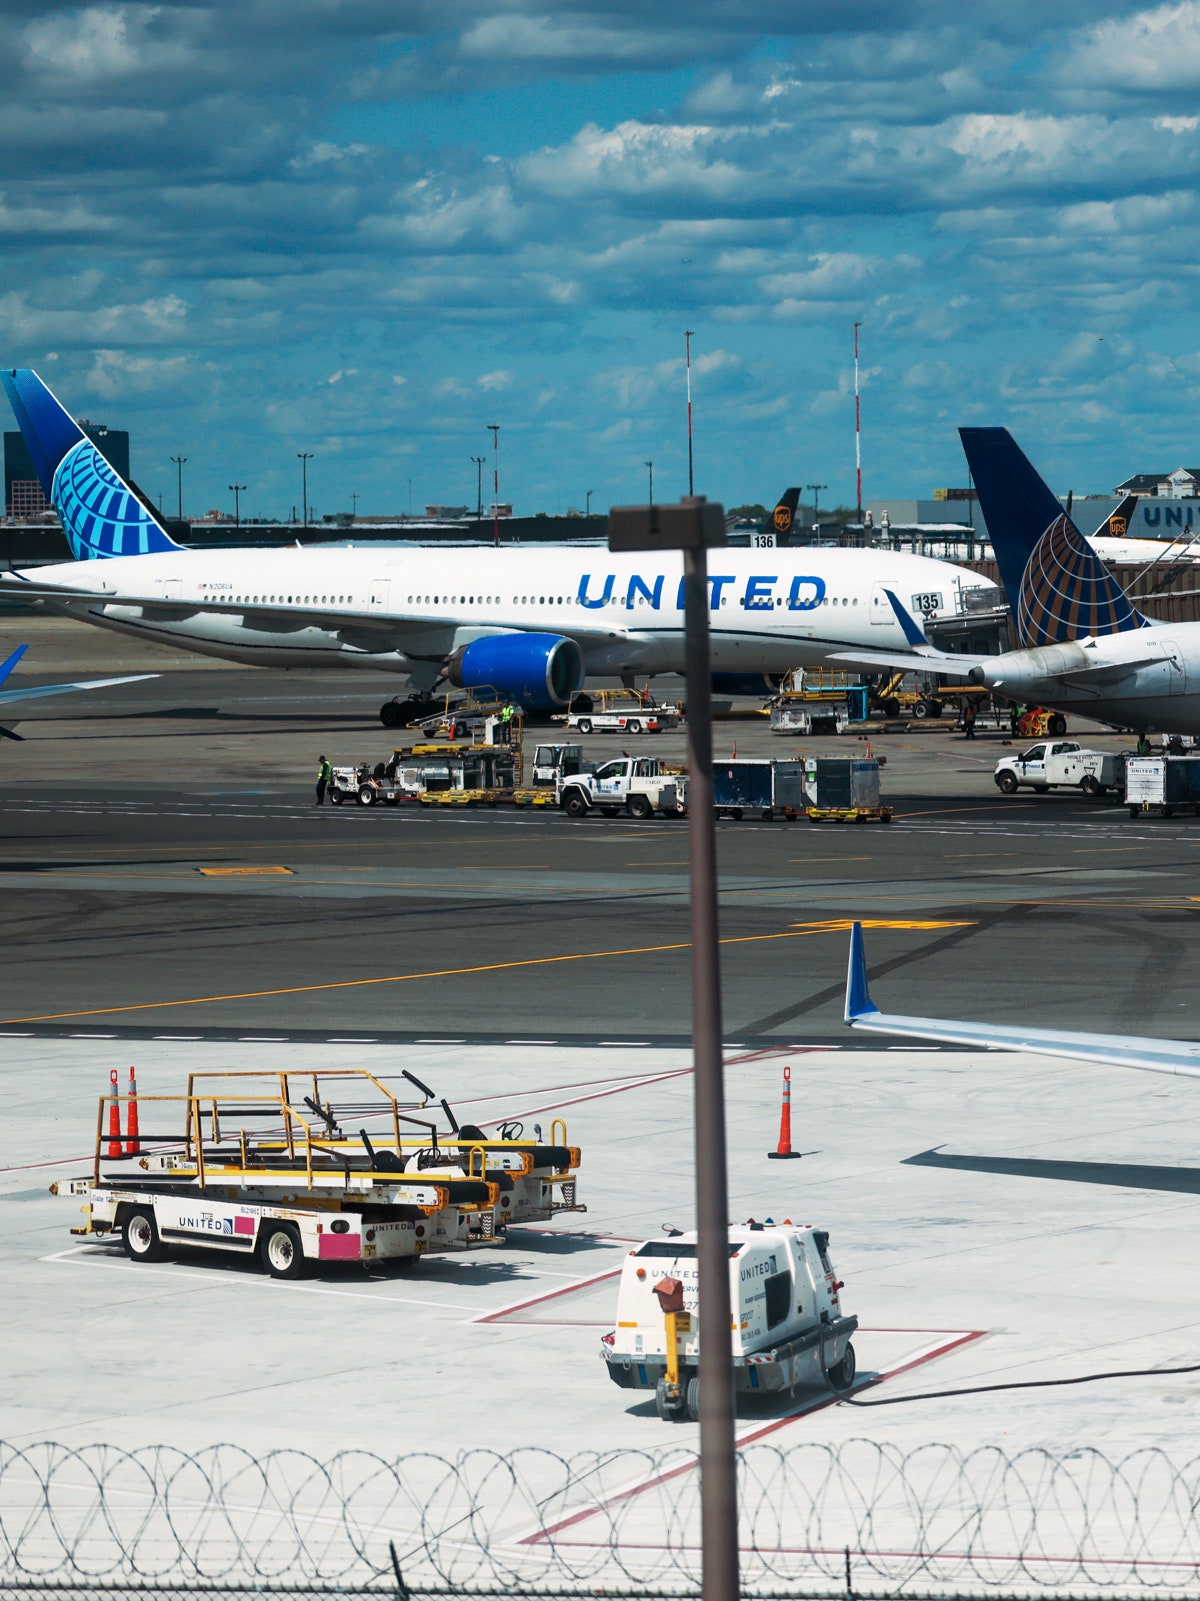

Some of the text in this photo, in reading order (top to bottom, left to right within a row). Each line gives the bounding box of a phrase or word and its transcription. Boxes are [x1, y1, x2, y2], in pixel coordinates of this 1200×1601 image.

[754, 536, 774, 548] 136
[916, 594, 939, 610] 135
[179, 1217, 222, 1230] UNITED
[373, 1223, 407, 1232] UNITED
[652, 1270, 699, 1278] UNITED
[741, 1261, 770, 1281] UNITED
